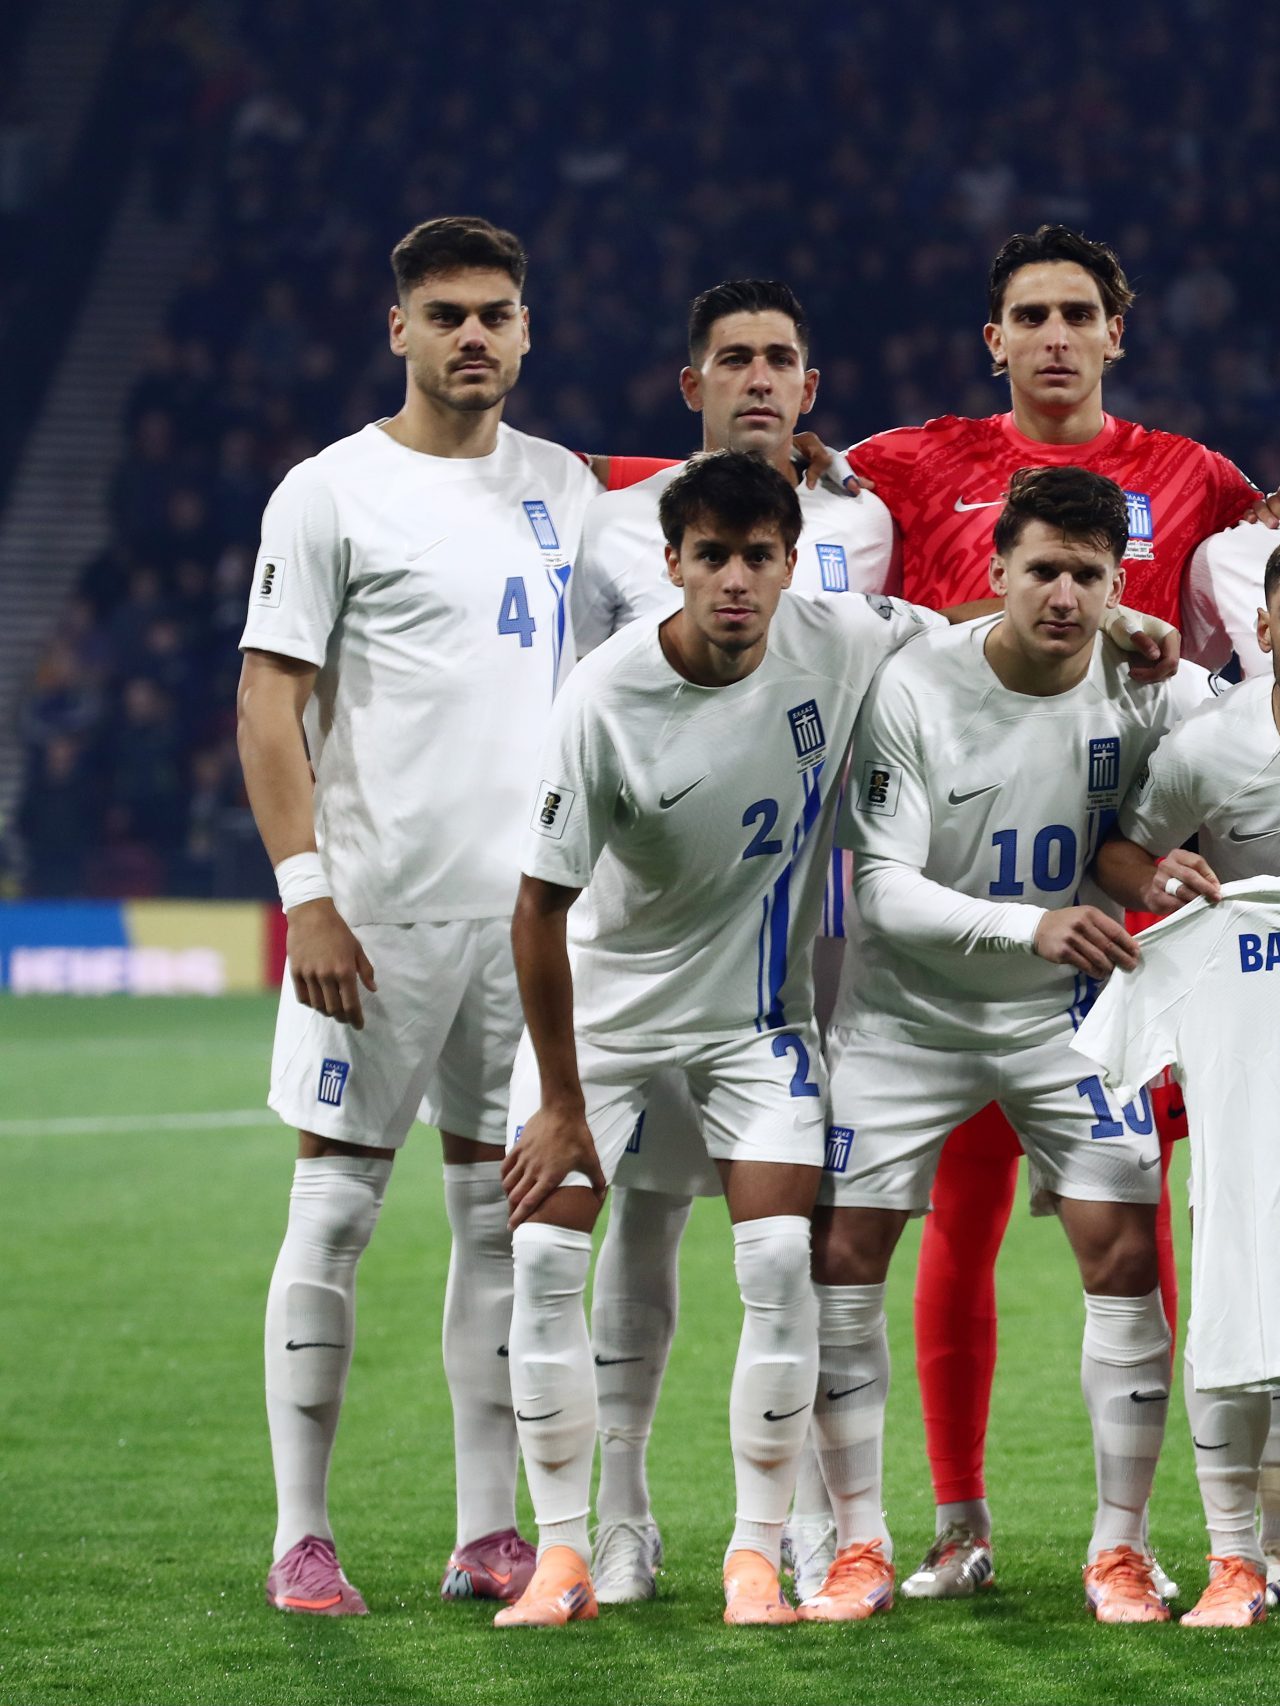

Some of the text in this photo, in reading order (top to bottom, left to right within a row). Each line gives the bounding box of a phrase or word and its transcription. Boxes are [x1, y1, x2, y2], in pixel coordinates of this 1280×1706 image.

[497, 576, 536, 648] 4
[742, 798, 783, 860] 2
[989, 824, 1077, 896] 10
[771, 1032, 820, 1098] 2
